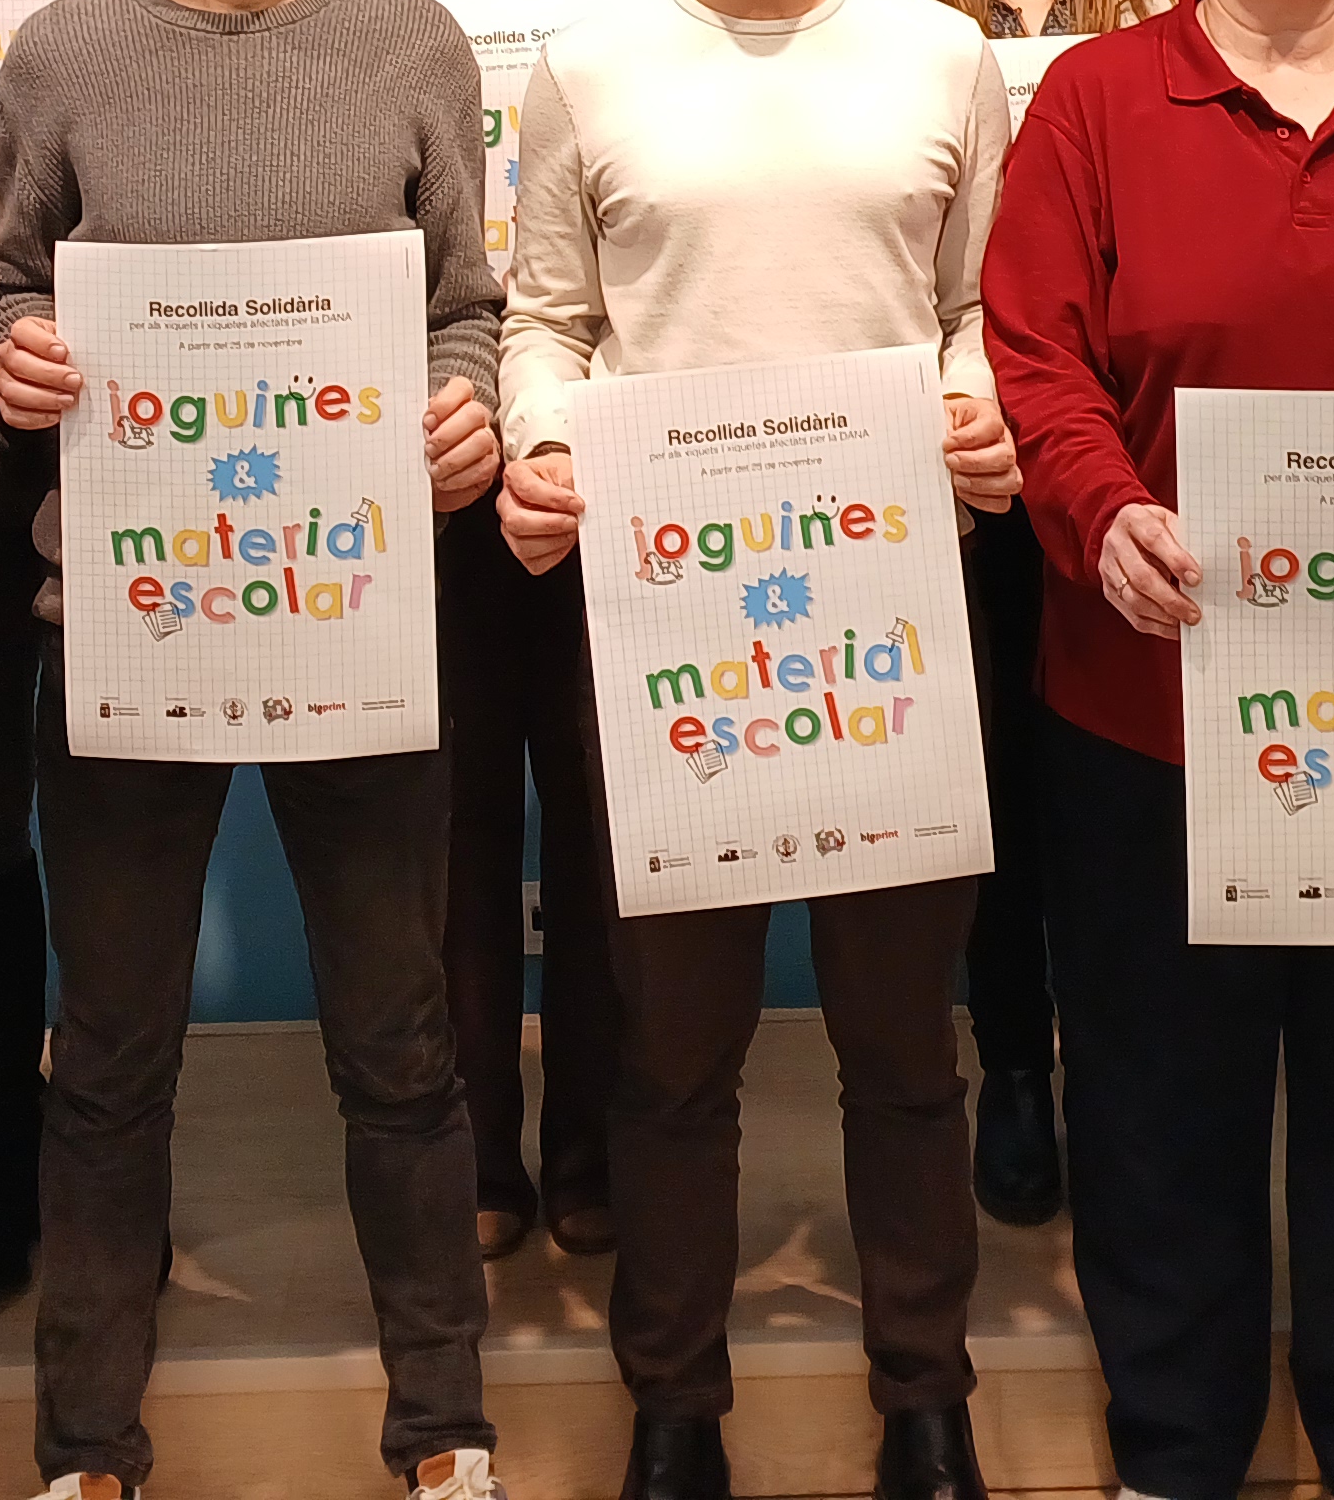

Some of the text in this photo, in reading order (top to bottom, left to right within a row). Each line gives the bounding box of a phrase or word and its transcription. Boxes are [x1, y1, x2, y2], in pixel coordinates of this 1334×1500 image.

[149, 295, 331, 317] Recollida Solidària
[668, 412, 848, 446] Recollida Solidària
[232, 459, 257, 489] &
[110, 502, 387, 566] material
[128, 566, 373, 622] escolar
[766, 584, 790, 614] &
[645, 622, 925, 710] material
[669, 692, 915, 758] escolar
